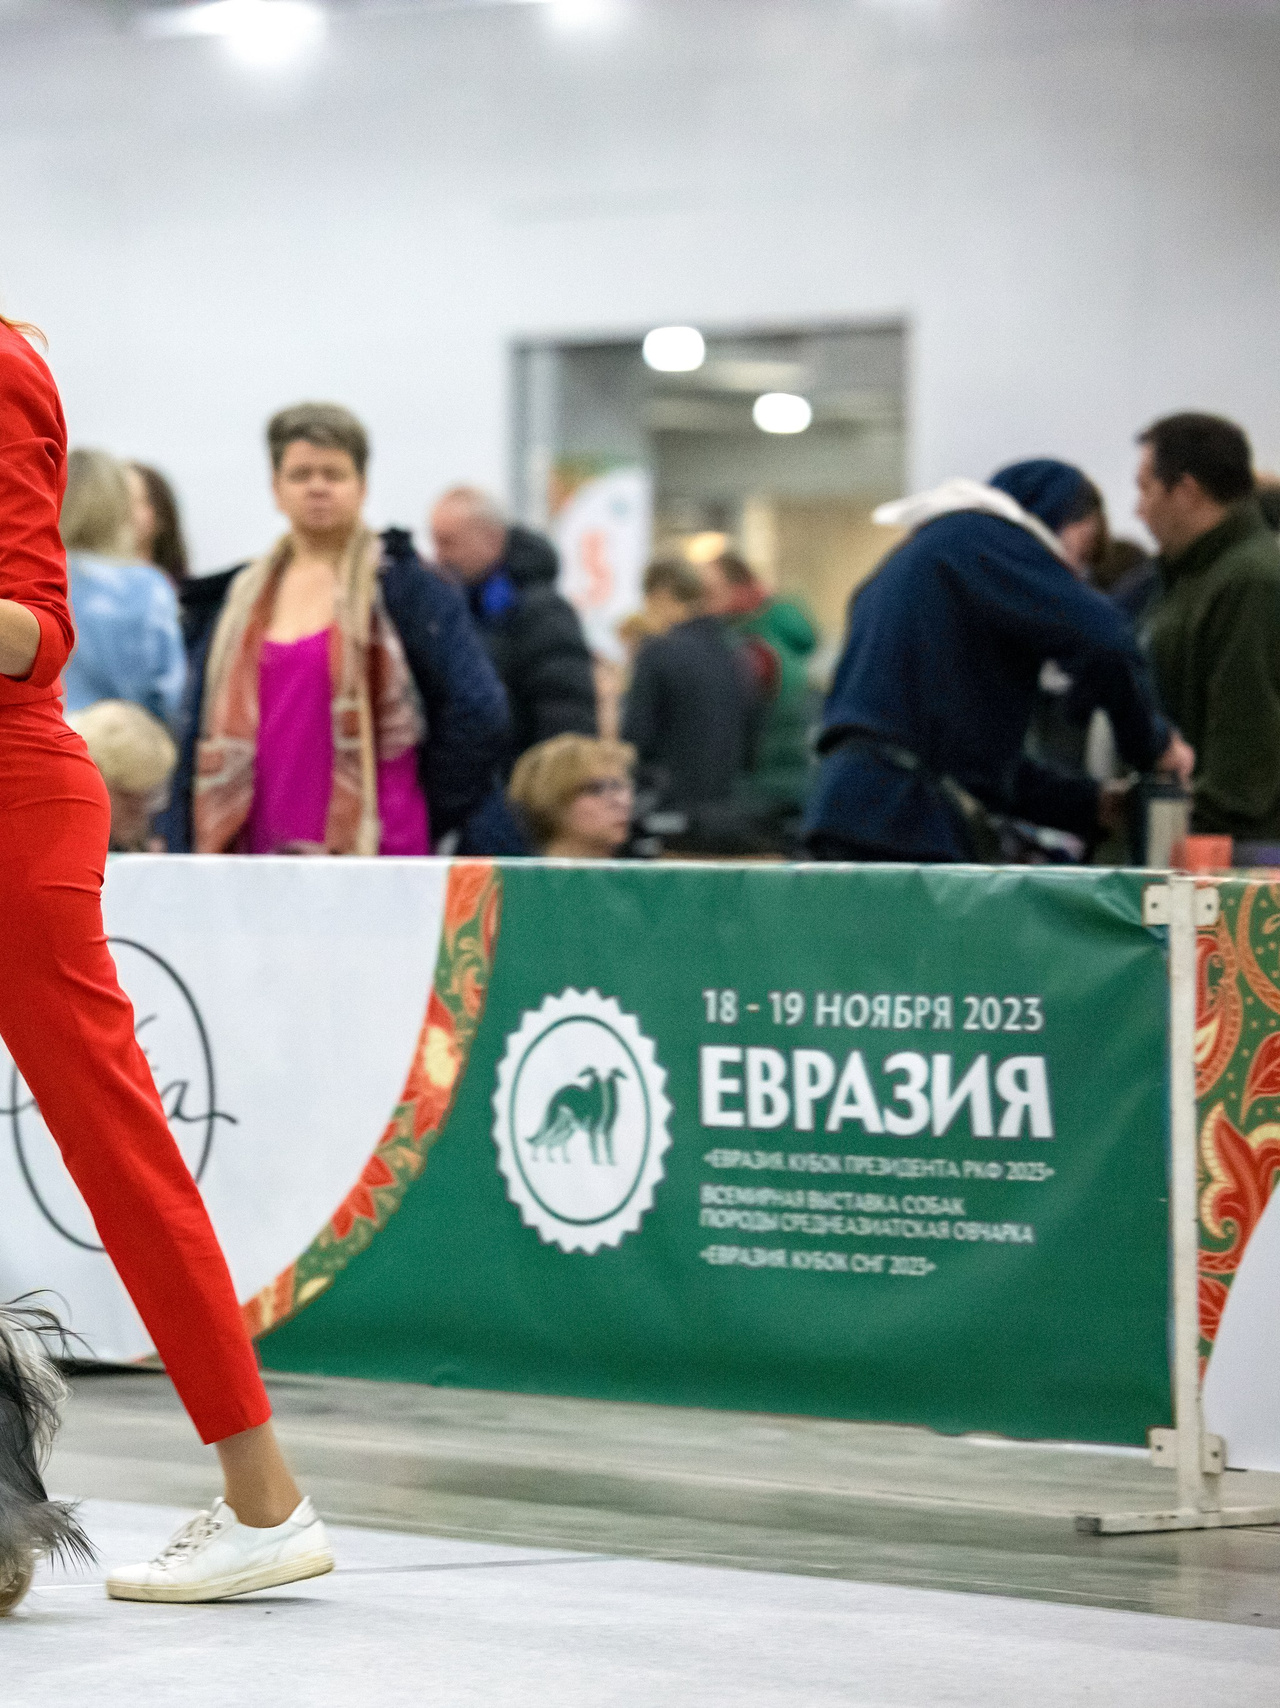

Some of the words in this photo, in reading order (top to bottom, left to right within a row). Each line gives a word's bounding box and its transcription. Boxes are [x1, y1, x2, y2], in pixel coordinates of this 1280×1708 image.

[704, 990, 737, 1024] 18
[770, 991, 804, 1025] 19
[816, 993, 953, 1028] НОЯБРЯ
[963, 996, 1044, 1031] 2023
[701, 1045, 1055, 1139] ЕВРАЗИЯ
